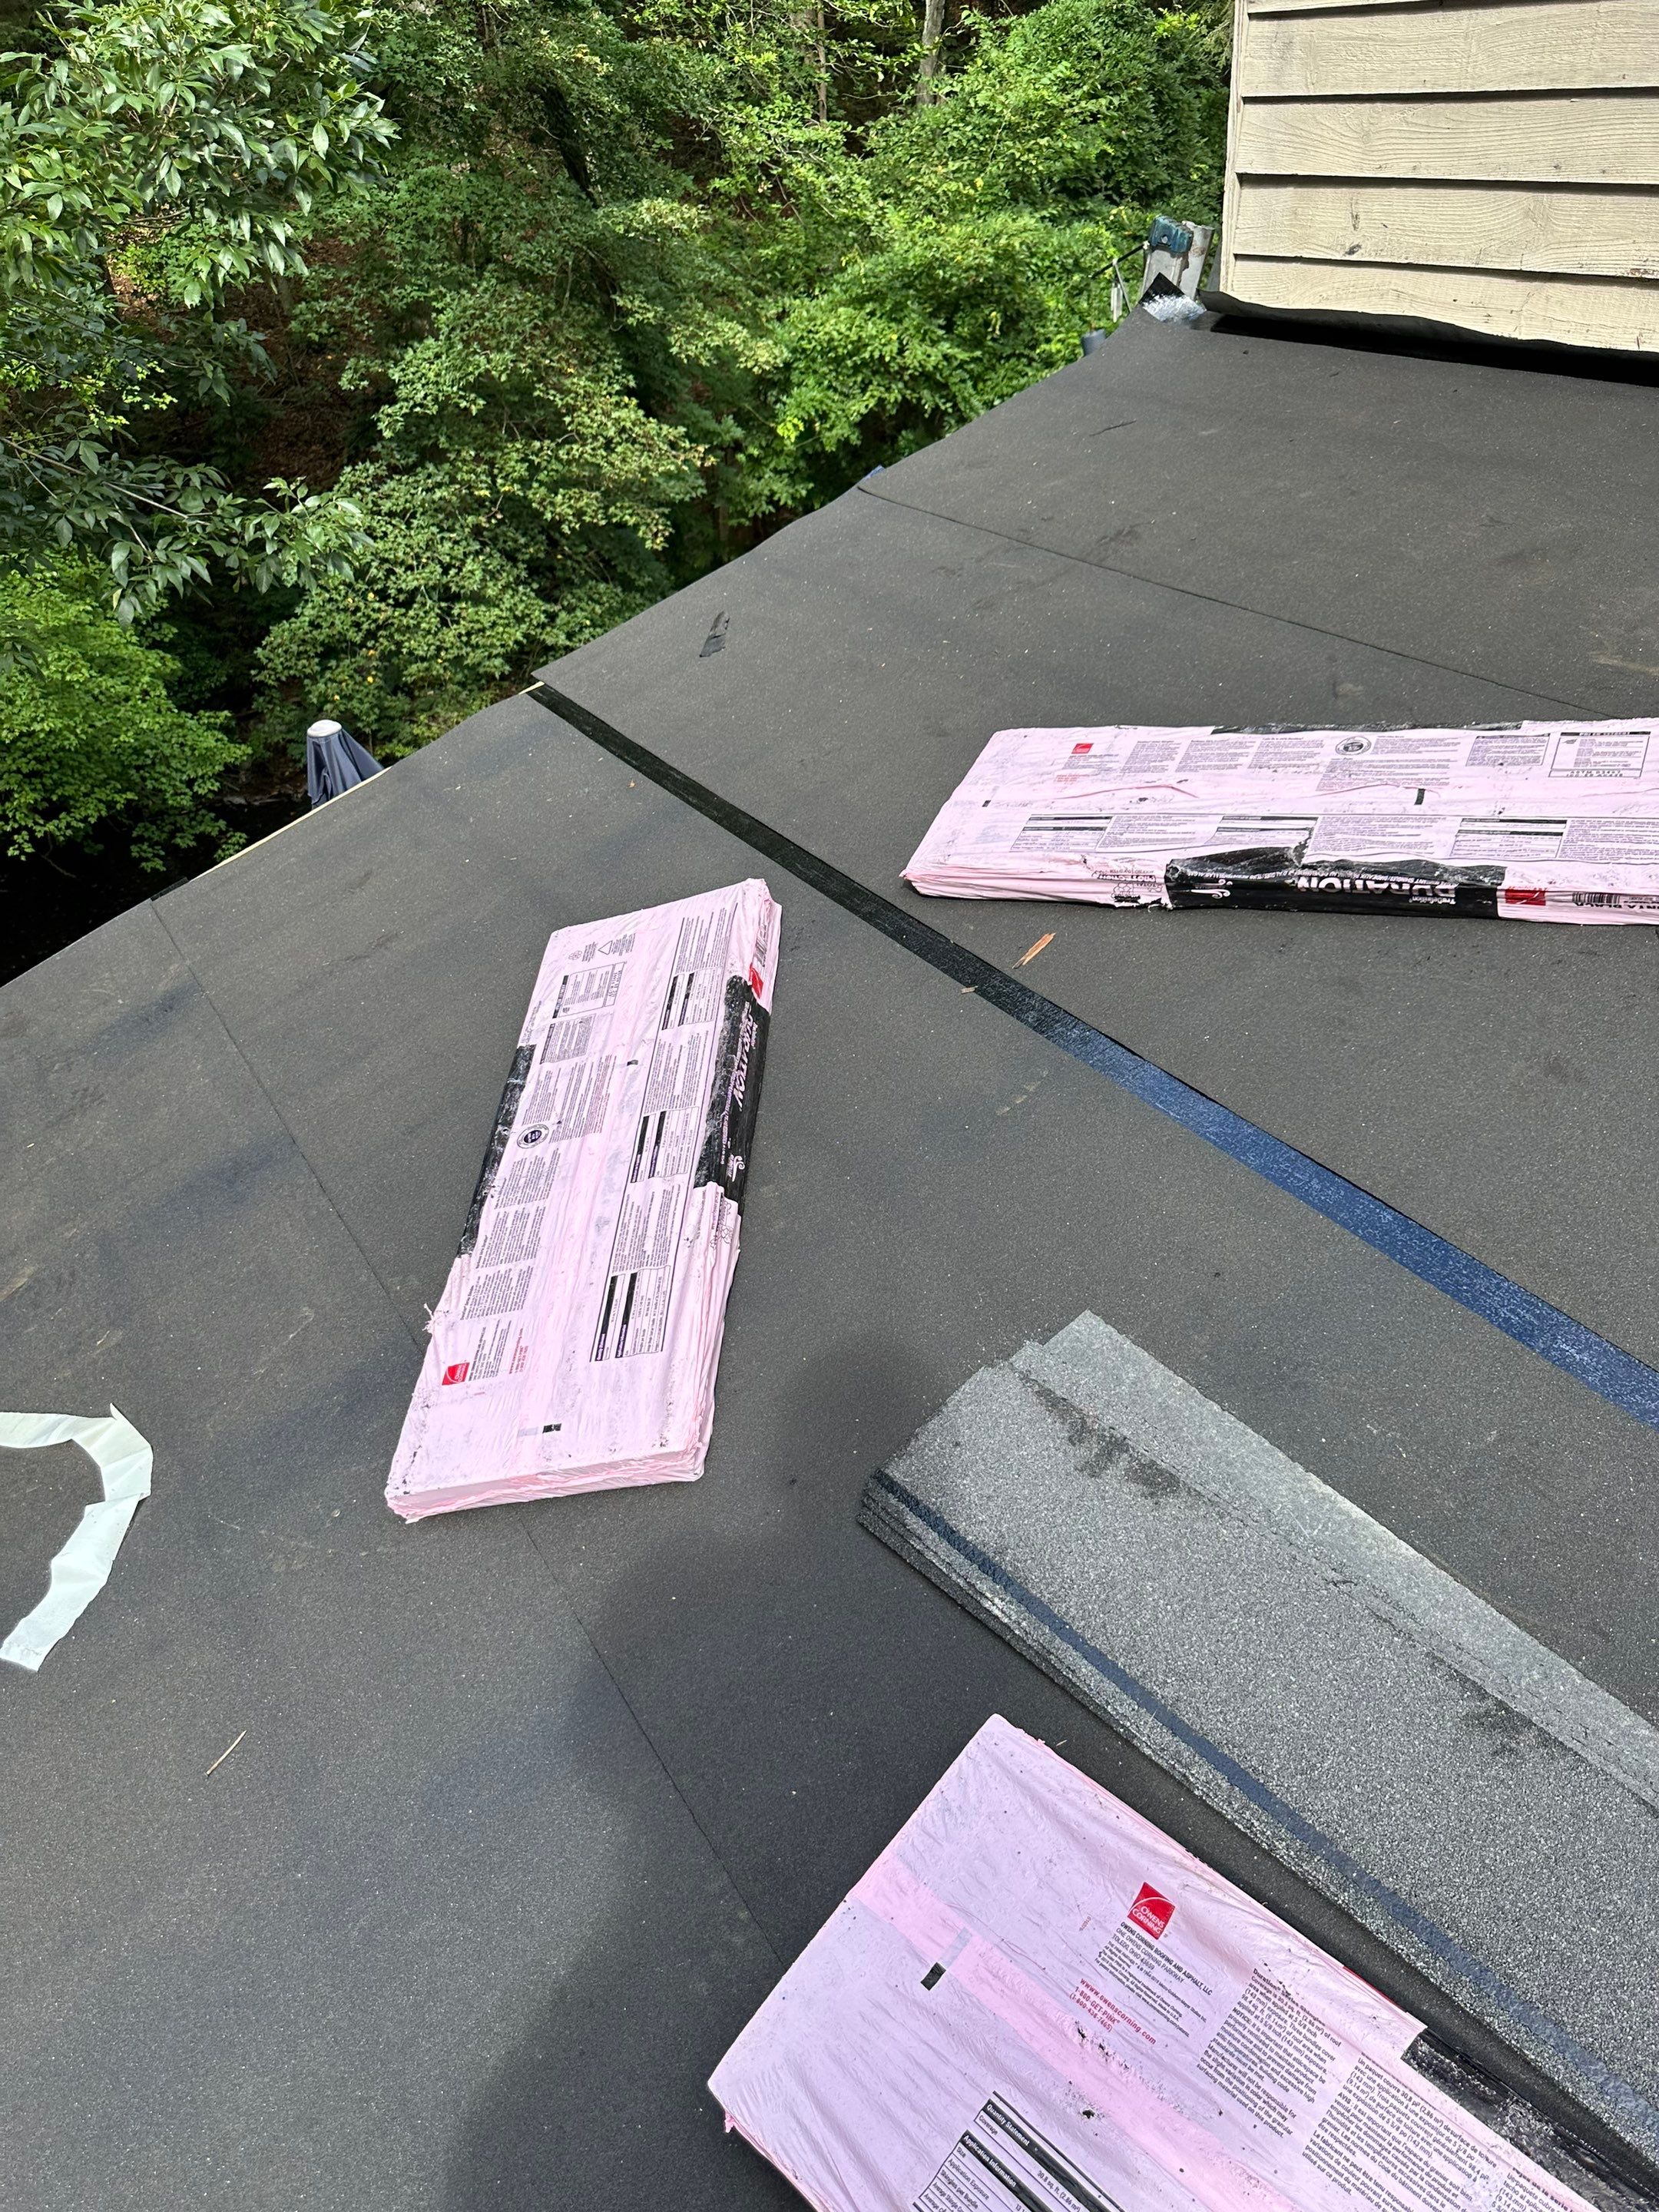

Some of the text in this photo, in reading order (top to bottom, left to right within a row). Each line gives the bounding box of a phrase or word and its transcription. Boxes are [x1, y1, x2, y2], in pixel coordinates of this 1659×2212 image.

[1293, 875, 1456, 898] DURATION
[1130, 1906, 1164, 1935] CORNING
[1137, 1904, 1167, 1929] OWENS
[1114, 1926, 1184, 1984] ONE OWENS CORNING PARKWAY
[1119, 1920, 1137, 1936] OWENS
[1134, 1932, 1155, 1951] CORNING
[1153, 1947, 1174, 1965] ROOFING
[1171, 1962, 1184, 1973] AND
[1201, 1985, 1213, 1995] LLC
[1128, 1947, 1141, 1960] OHIO
[1139, 1956, 1155, 1971] 43659
[1303, 2082, 1318, 2095] from
[975, 2114, 1000, 2136] Coverage
[985, 2103, 1031, 2146] Quantity Statement
[961, 2134, 1018, 2187] Application Information
[937, 2168, 959, 2190] Shingles
[962, 2192, 980, 2209] Bundle
[945, 2157, 991, 2200] Application Exposure
[1035, 2169, 1049, 2183] 30.8
